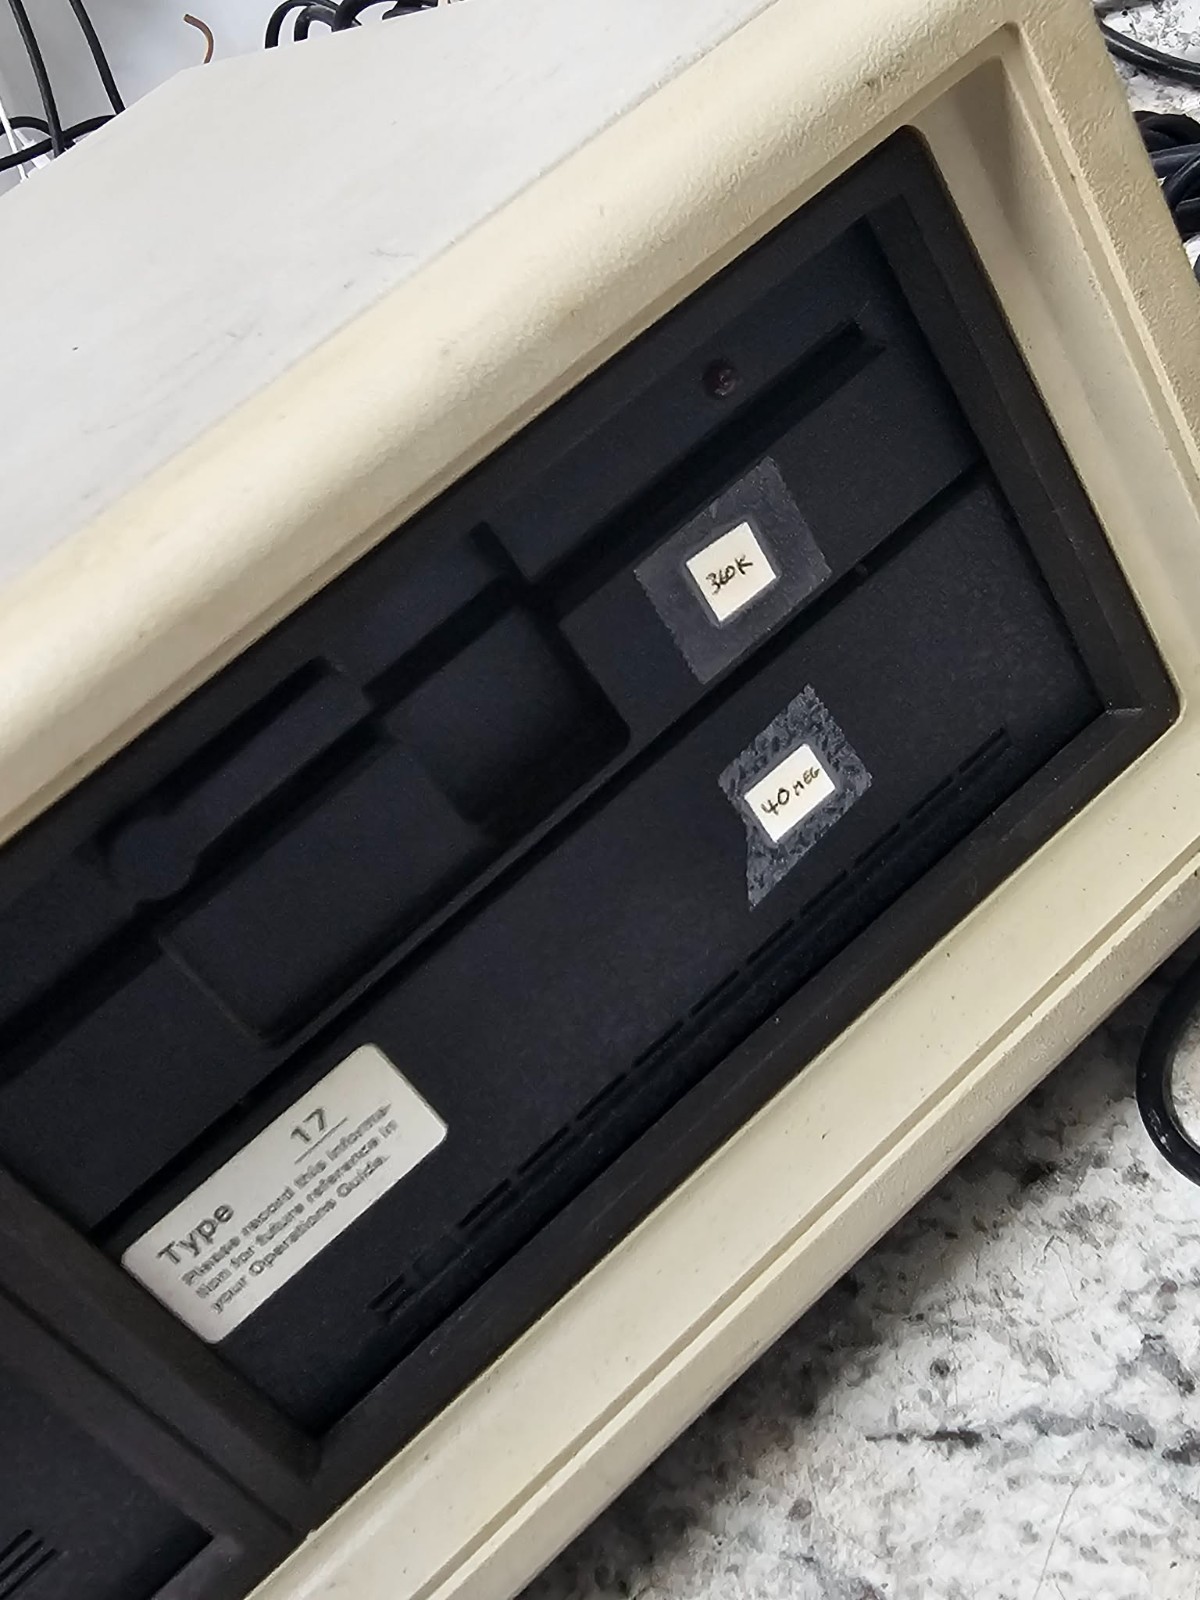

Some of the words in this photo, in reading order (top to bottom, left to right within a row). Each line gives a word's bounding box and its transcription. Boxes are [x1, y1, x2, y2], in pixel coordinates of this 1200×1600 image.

[706, 555, 753, 595] 360K
[761, 788, 790, 816] 40
[793, 767, 820, 796] MEG
[156, 1204, 234, 1266] Type
[290, 1107, 327, 1144] 17
[181, 1236, 241, 1286] Please
[241, 1186, 295, 1237] record
[294, 1160, 327, 1189] this
[230, 1247, 256, 1269] for
[255, 1203, 305, 1247] future
[306, 1136, 380, 1203] reference
[378, 1119, 398, 1138] in
[211, 1277, 248, 1315] your
[249, 1199, 338, 1278] Operations
